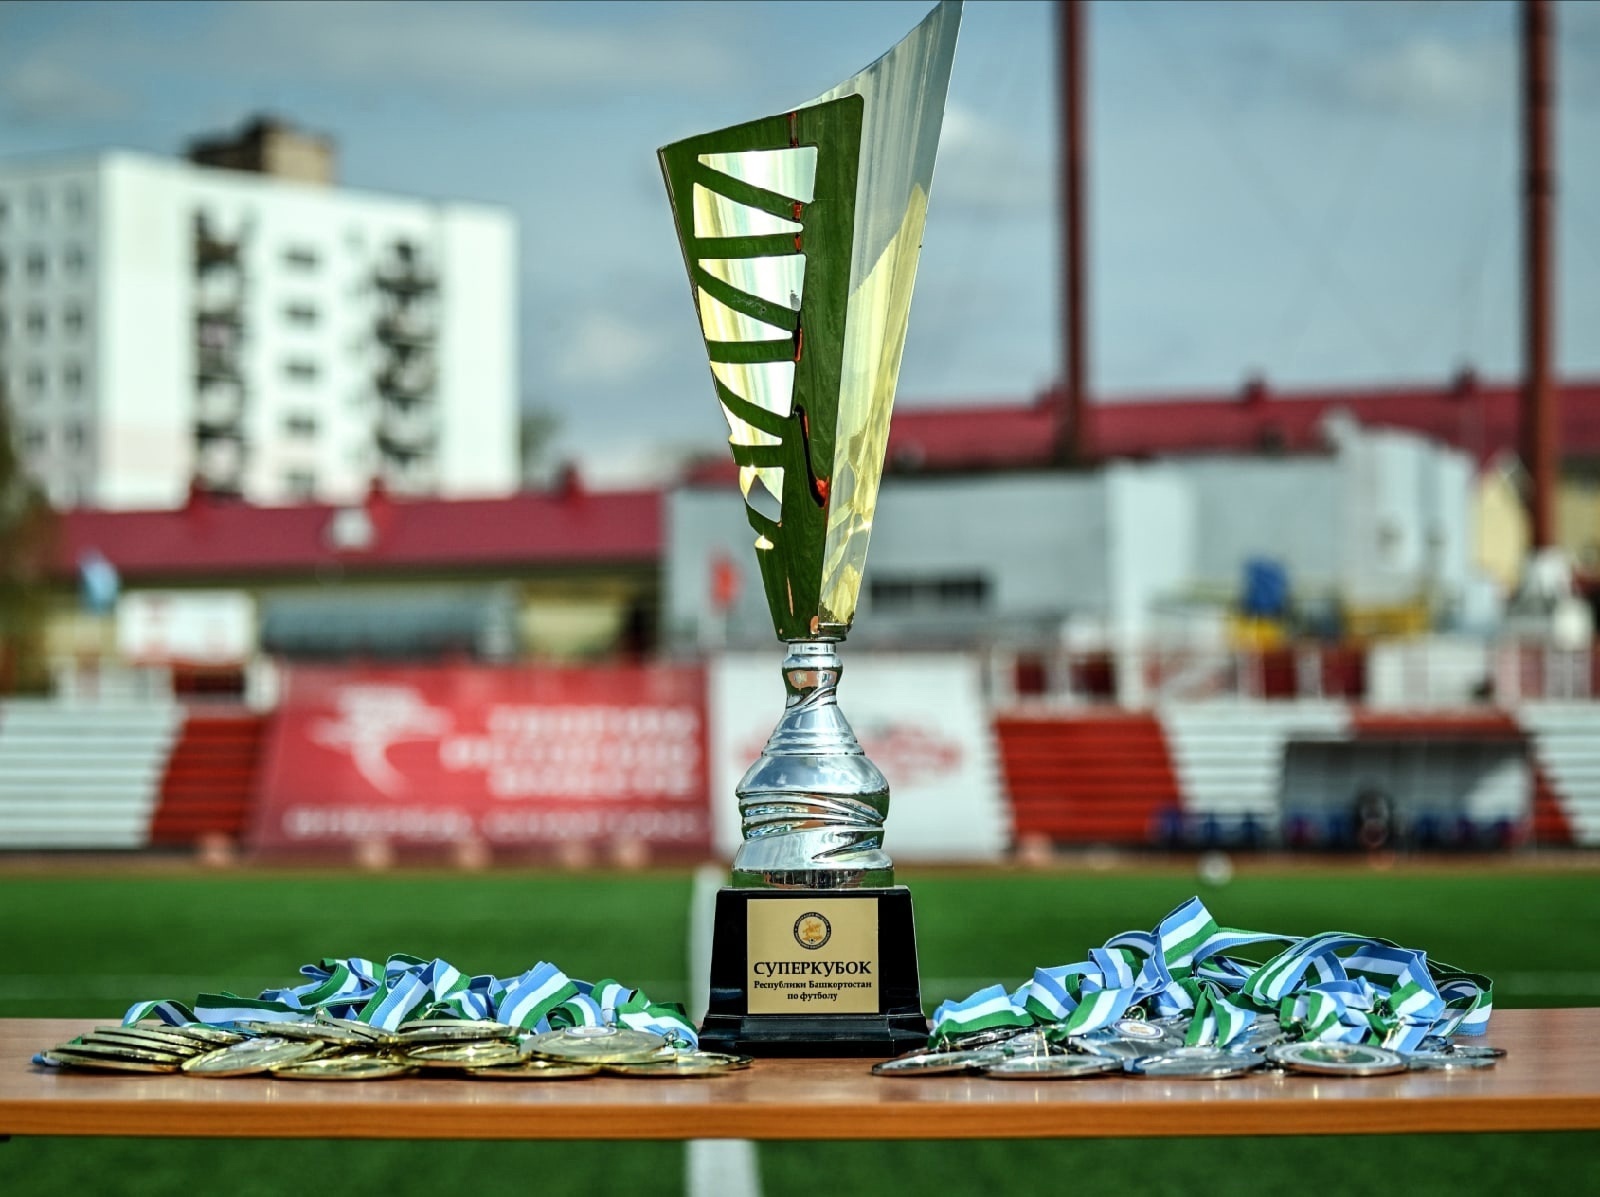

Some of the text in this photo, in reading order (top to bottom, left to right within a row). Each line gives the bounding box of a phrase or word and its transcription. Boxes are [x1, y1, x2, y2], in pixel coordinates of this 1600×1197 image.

[753, 961, 872, 977] СУПЕРКУБОК
[753, 980, 872, 991] Республики Башкортостан
[800, 992, 838, 1002] футболу
